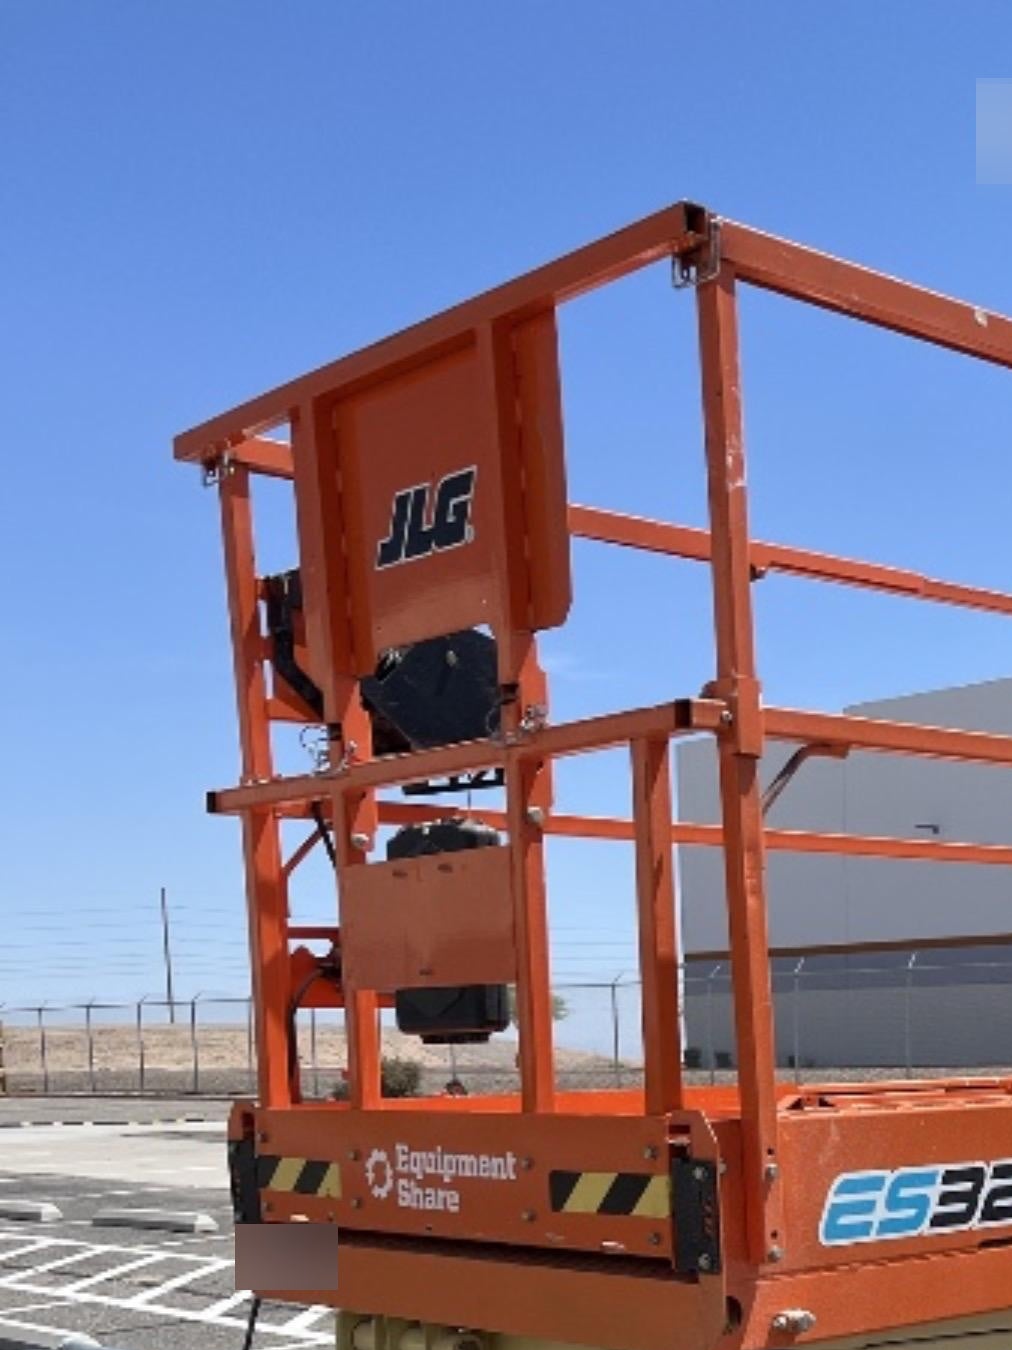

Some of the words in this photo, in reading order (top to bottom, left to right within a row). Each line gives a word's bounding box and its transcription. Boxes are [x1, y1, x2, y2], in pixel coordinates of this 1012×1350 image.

[374, 464, 478, 571] JLG
[395, 1142, 517, 1184] Equipment
[398, 1178, 461, 1213] Share
